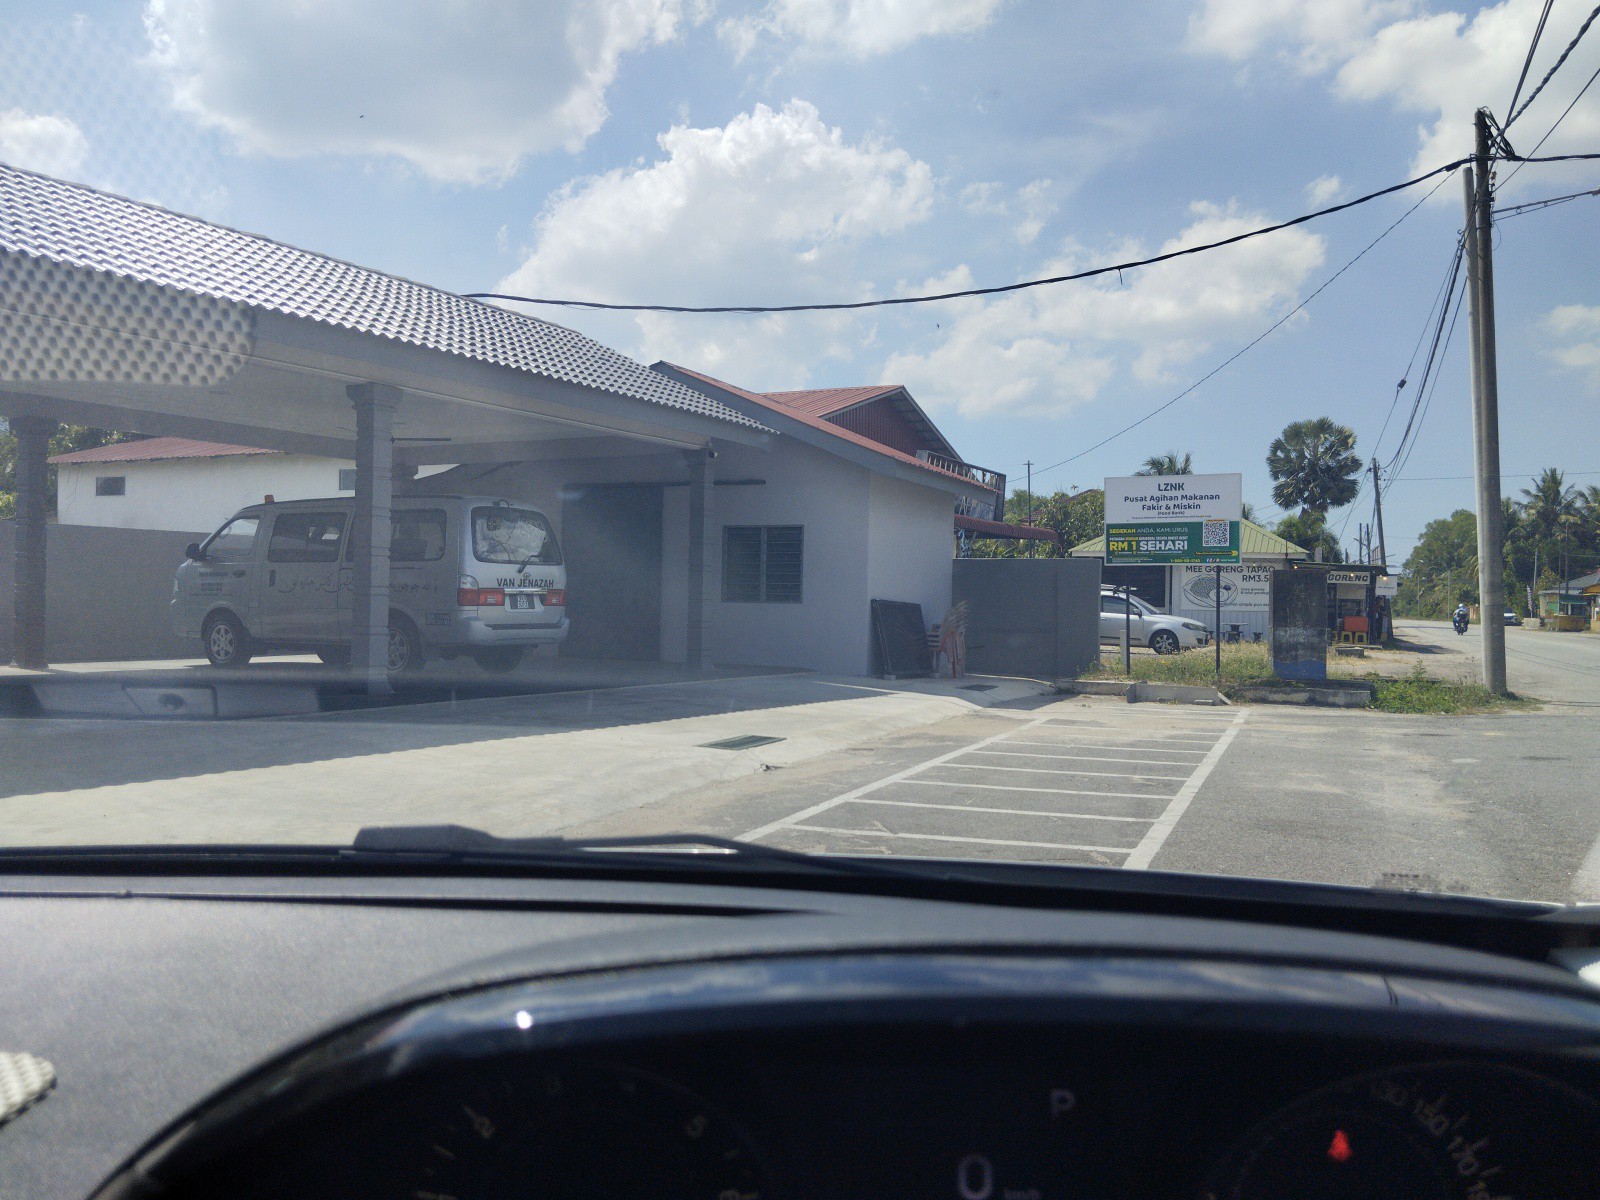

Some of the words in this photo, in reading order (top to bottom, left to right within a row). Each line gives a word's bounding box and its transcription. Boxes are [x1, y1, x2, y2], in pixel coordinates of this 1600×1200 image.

[1158, 483, 1185, 491] LZNK
[1149, 494, 1179, 503] Agihan
[1173, 502, 1201, 510] Miskin
[1109, 541, 1128, 551] RM
[1131, 541, 1137, 551] 1
[1139, 540, 1188, 550] SEHARI
[1185, 565, 1203, 573] MEE
[496, 578, 515, 587] VAN
[517, 578, 554, 589] JENAZAH
[1050, 1088, 1076, 1119] P
[957, 1153, 994, 1200] 0
